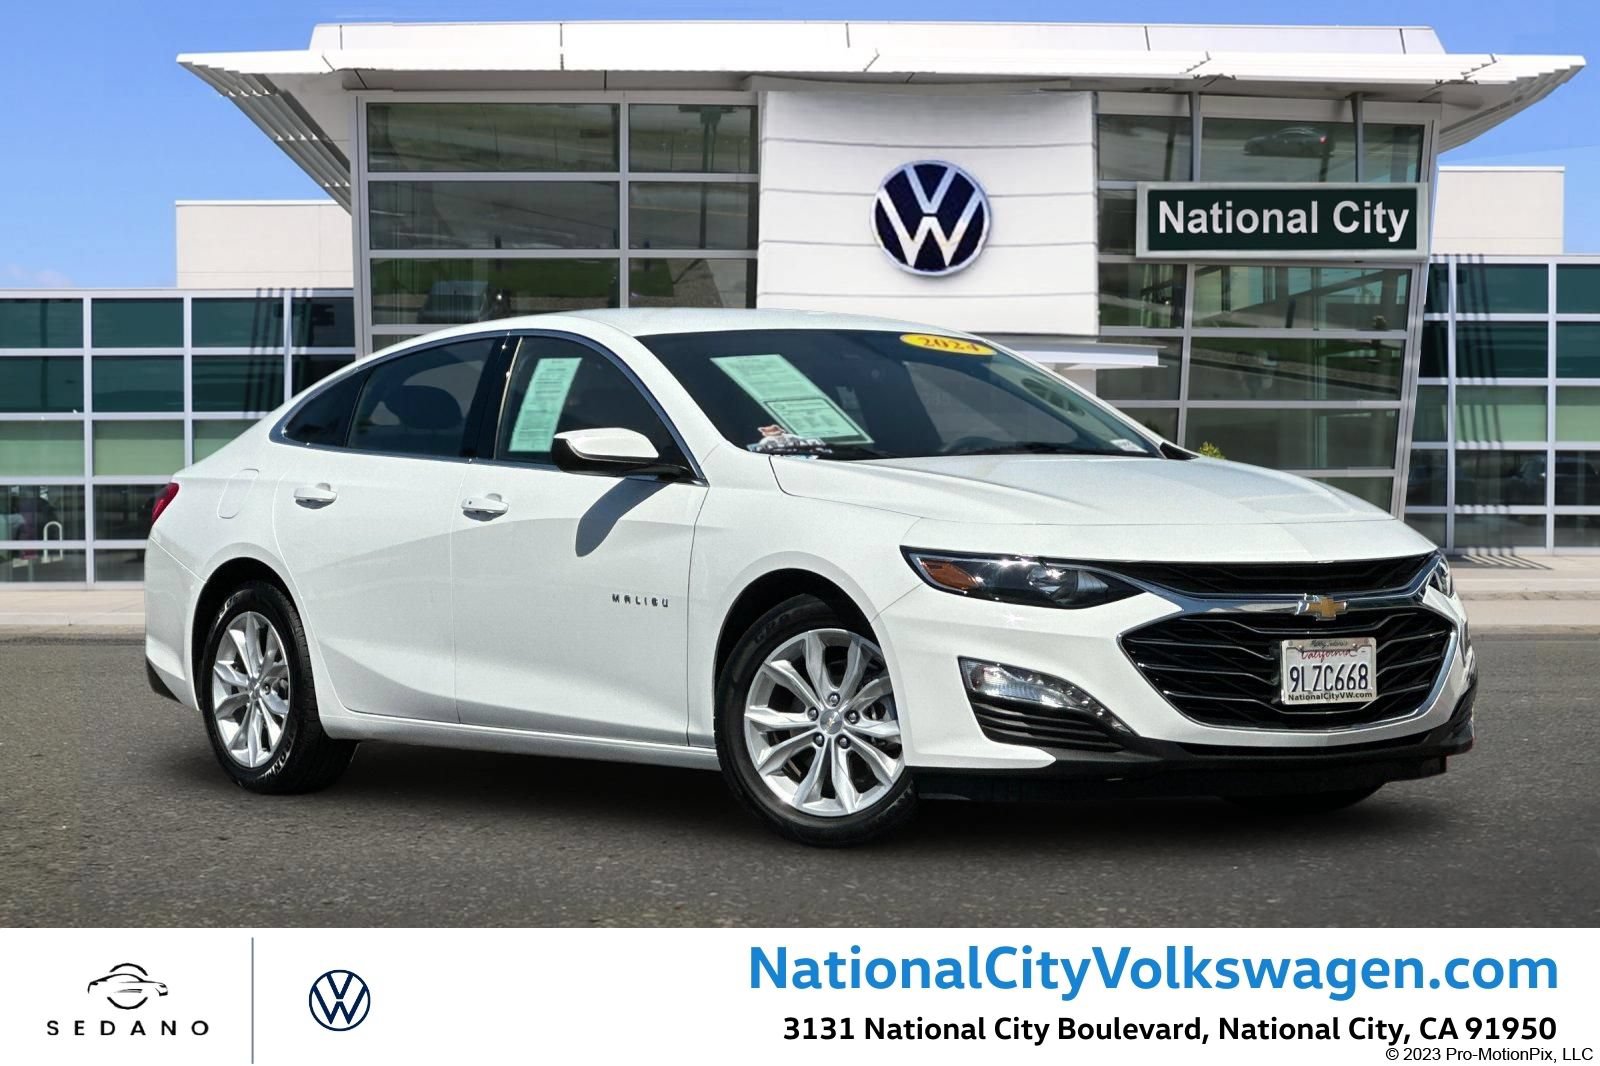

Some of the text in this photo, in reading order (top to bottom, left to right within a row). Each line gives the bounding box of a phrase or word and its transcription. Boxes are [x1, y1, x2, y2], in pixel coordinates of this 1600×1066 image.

[1158, 200, 1410, 243] National City
[917, 336, 980, 351] 2024
[611, 593, 669, 608] MALIBU
[1289, 663, 1369, 693] 9LZC668
[1288, 691, 1373, 701] NationalCityVW.com
